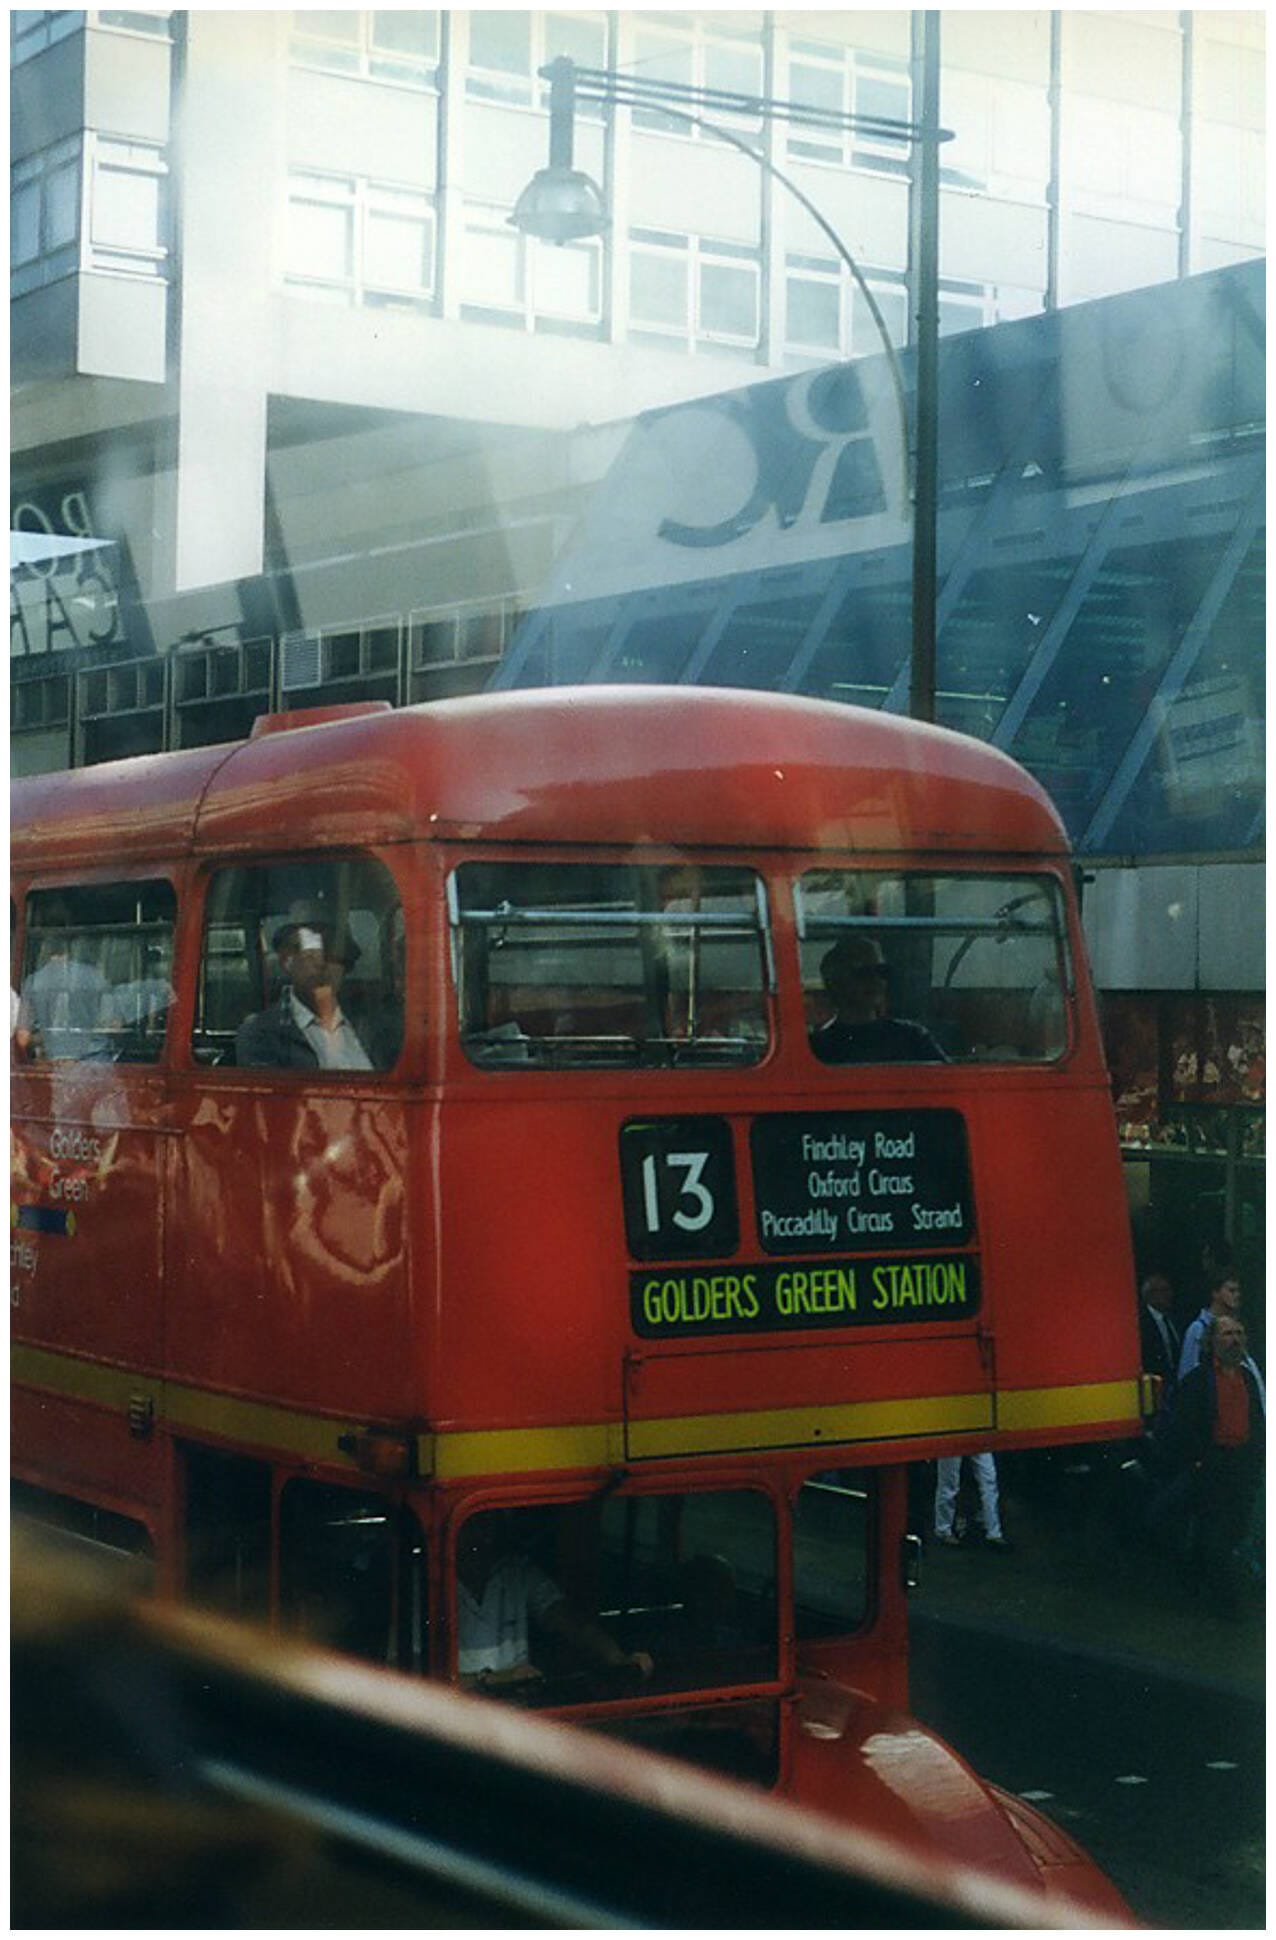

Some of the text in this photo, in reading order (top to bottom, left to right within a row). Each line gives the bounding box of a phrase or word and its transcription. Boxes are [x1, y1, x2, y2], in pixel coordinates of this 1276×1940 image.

[51, 1127, 101, 1162] Golders
[803, 1132, 914, 1167] Finchley Road
[50, 1167, 88, 1201] Green
[643, 1153, 713, 1231] 13
[808, 1169, 914, 1197] Oxford Circus
[762, 1204, 962, 1241] Piccadilly Circus Strand
[644, 1264, 965, 1323] GOLDERS GREEN STATION
